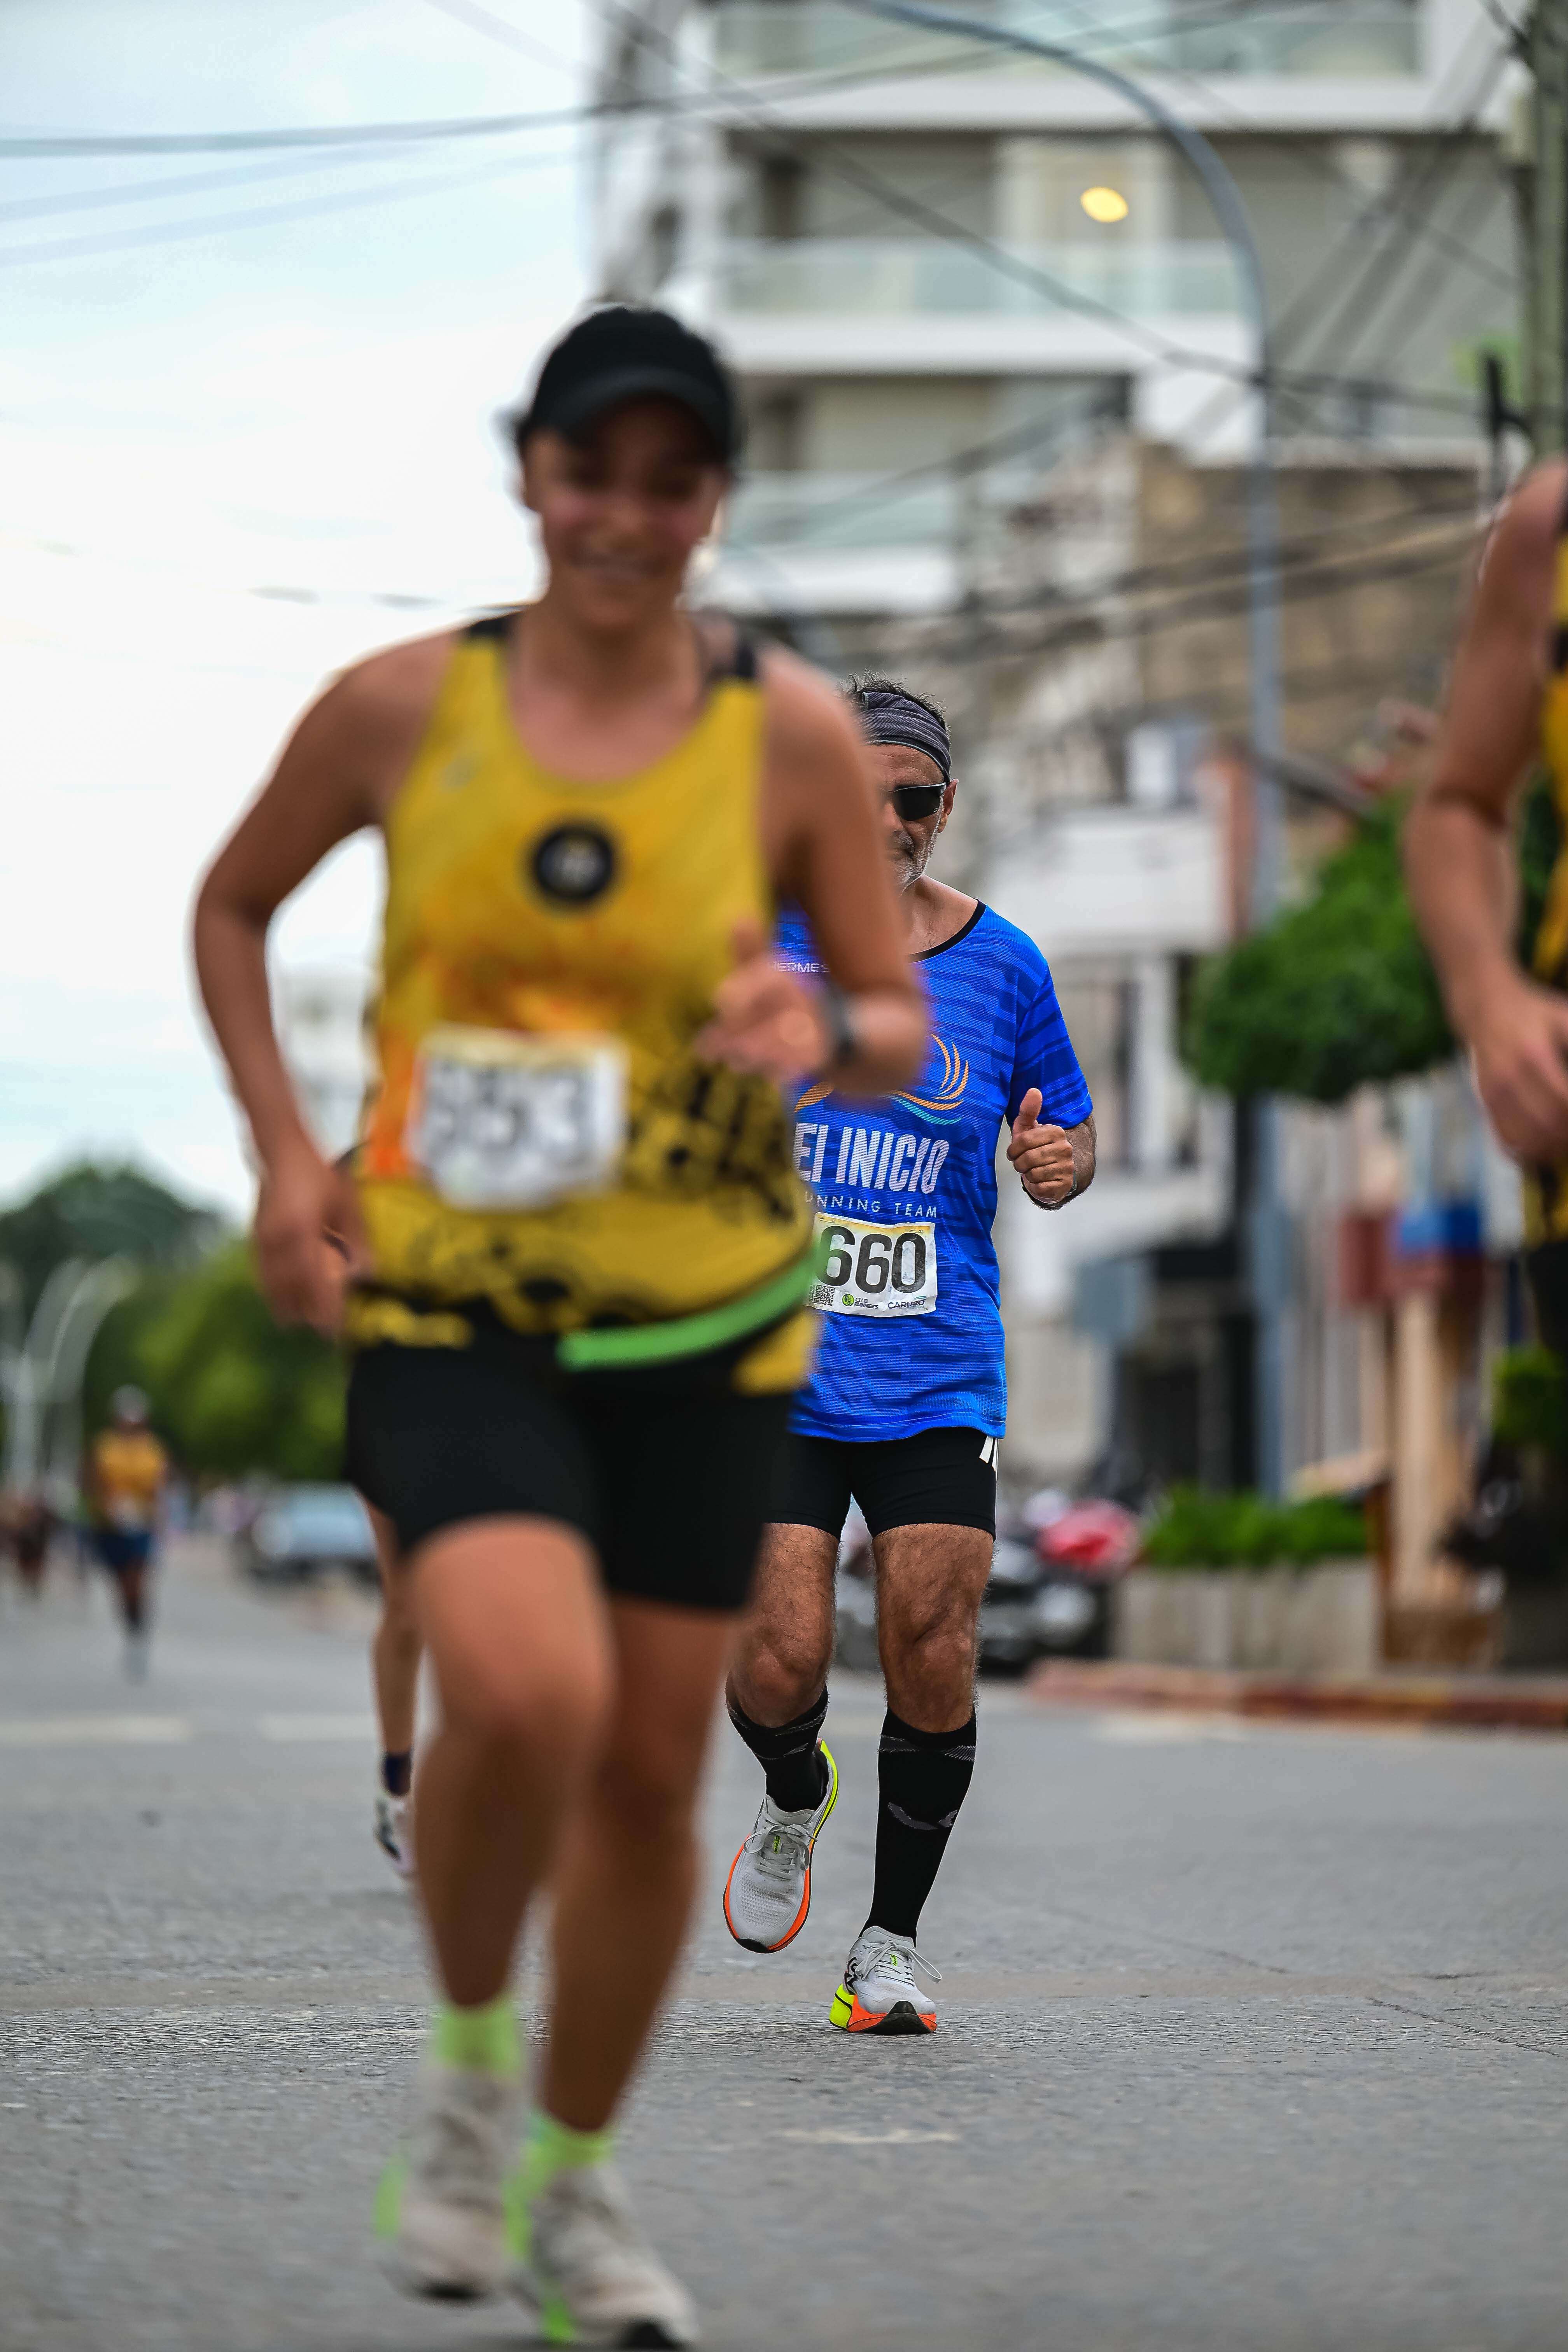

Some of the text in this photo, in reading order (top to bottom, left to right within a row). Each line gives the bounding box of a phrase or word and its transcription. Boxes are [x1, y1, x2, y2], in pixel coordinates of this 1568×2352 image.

[835, 1127, 949, 1194] INICIO
[803, 1190, 937, 1218] UNNING TEAM
[816, 1225, 926, 1293] 660
[888, 1300, 925, 1309] CARUSO
